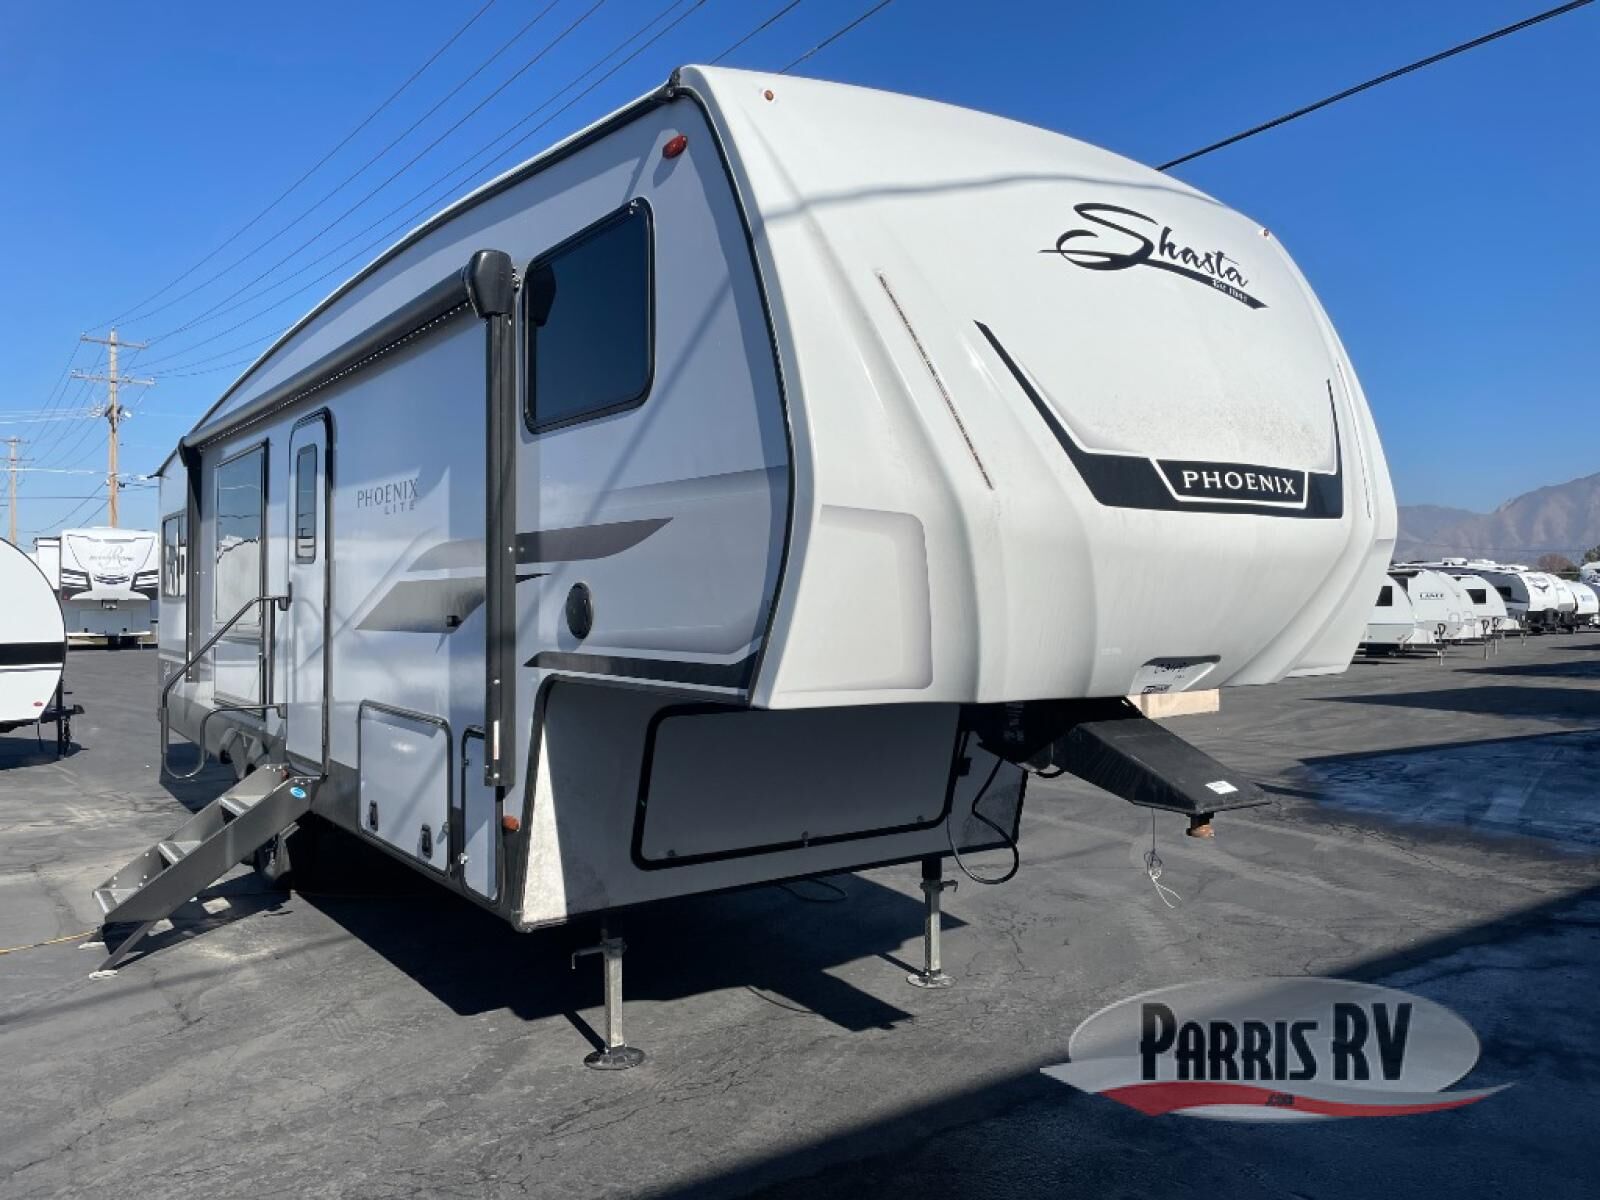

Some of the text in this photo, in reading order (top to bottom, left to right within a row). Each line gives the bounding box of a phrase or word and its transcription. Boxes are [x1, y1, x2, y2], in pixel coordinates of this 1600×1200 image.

[1041, 202, 1250, 288] Shasta
[357, 477, 418, 509] PHOENIX
[1182, 470, 1297, 495] PHOENIX
[384, 500, 416, 515] LITE
